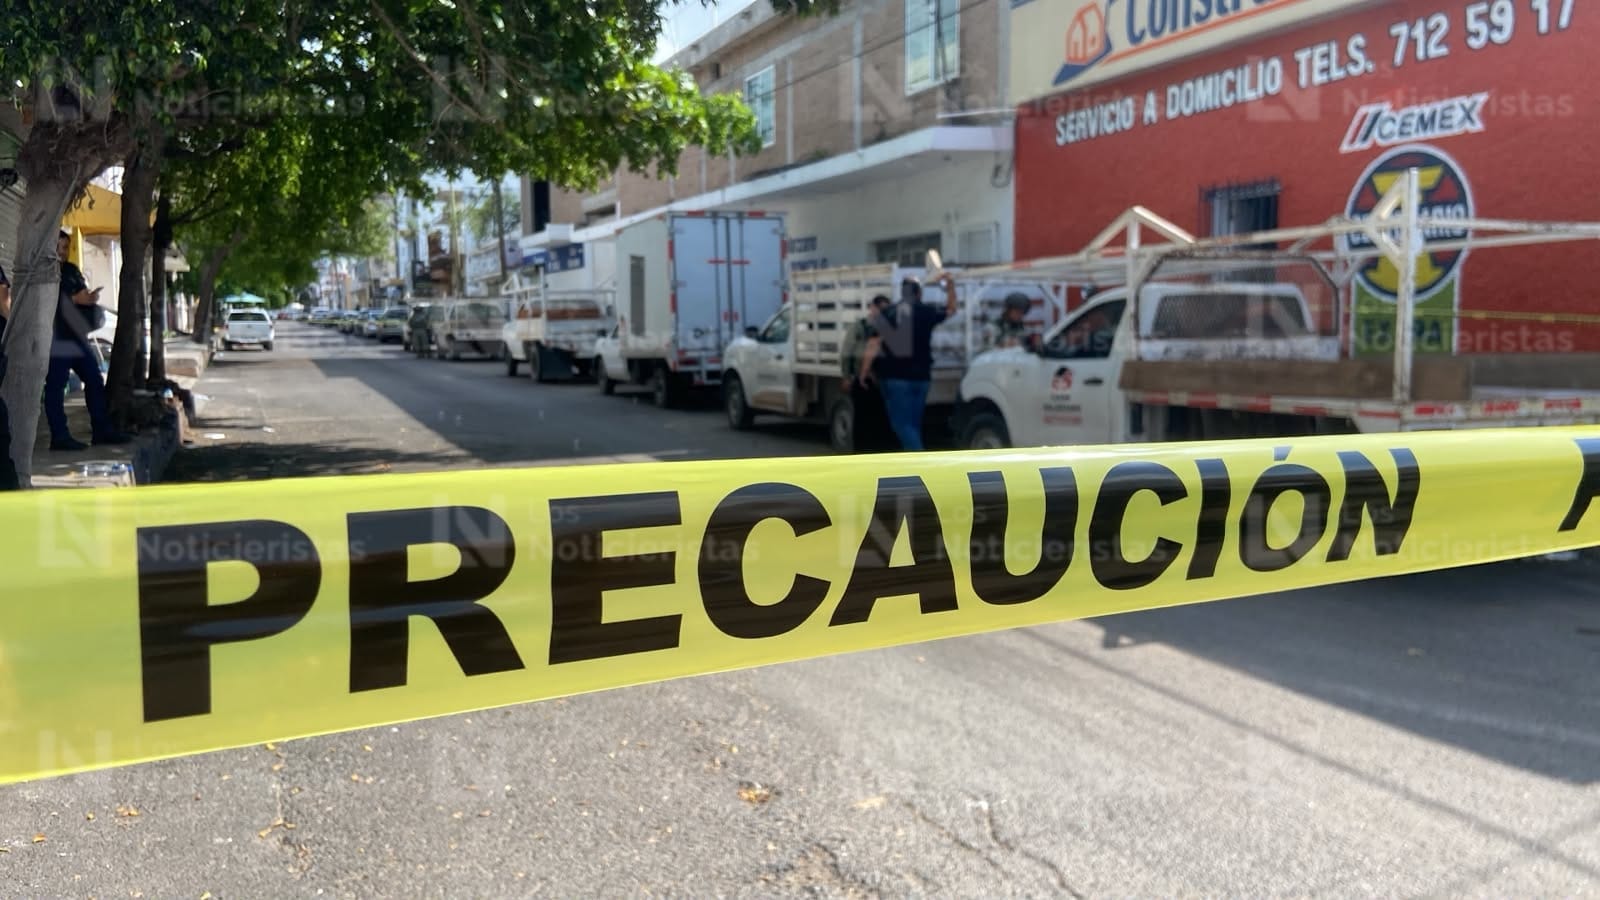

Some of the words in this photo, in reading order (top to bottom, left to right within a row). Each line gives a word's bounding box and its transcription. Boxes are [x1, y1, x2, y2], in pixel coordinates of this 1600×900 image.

[1056, 97, 1134, 145] SERVICIO
[1143, 91, 1158, 125] A
[1165, 57, 1283, 119] DOMICILIO
[1294, 34, 1374, 88] TELS.
[1390, 13, 1450, 67] 712
[1465, 0, 1515, 50] 59
[1374, 98, 1480, 140] CEMEX
[135, 446, 1421, 723] PRECAUCIÓN
